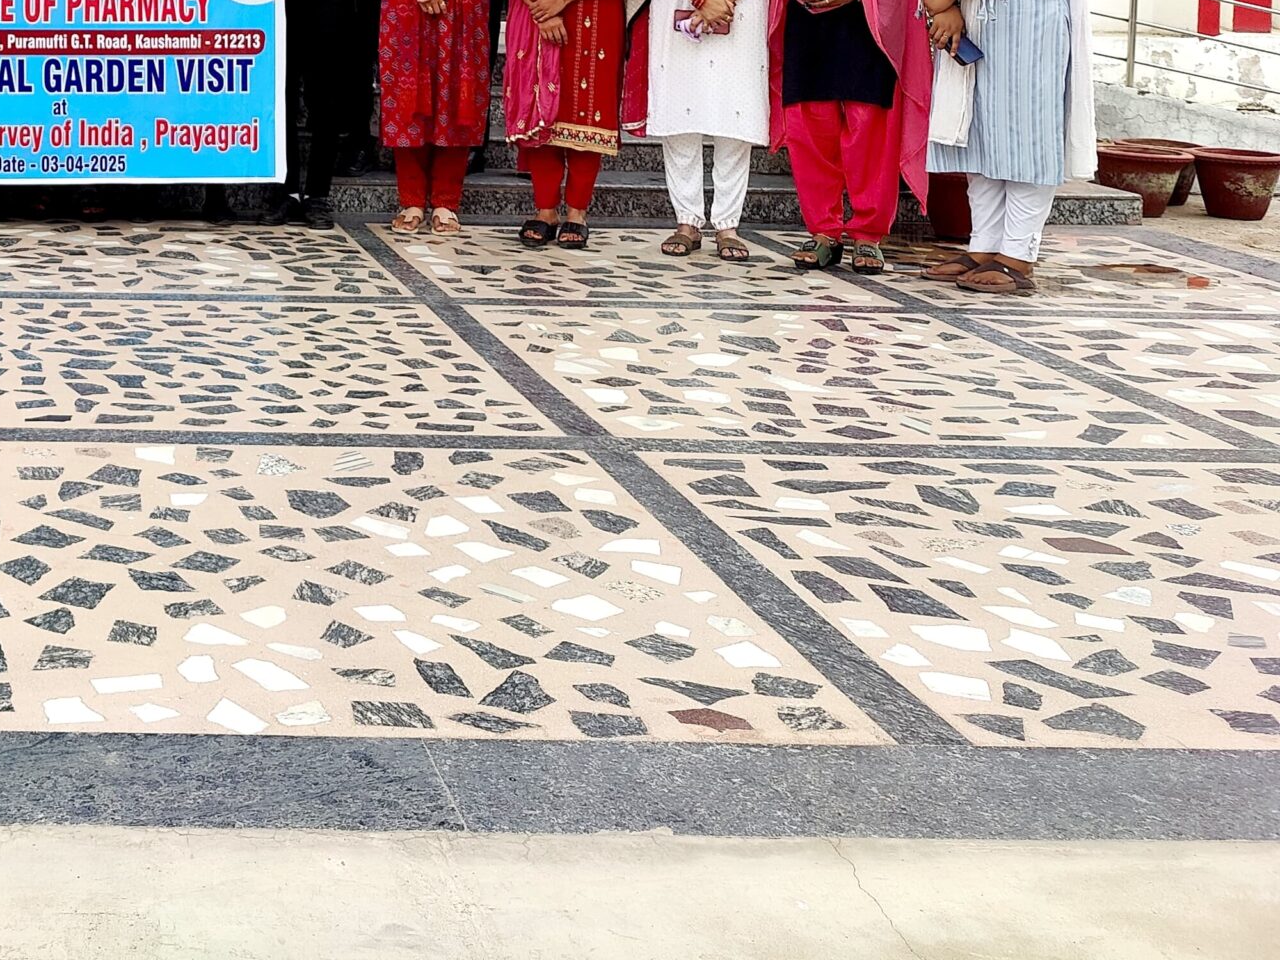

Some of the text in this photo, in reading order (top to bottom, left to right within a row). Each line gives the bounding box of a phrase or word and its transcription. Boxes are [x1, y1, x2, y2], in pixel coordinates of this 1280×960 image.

[7, 34, 68, 49] Puramufti
[71, 34, 93, 49] G.T.
[97, 34, 132, 51] Road,
[135, 34, 202, 49] Kaushambi
[214, 34, 261, 49] 212213
[44, 58, 165, 93] GARDEN
[176, 58, 253, 93] VISIT
[52, 99, 67, 115] at
[51, 119, 72, 146] of
[79, 119, 133, 146] India
[155, 119, 259, 152] Prayagraj
[41, 155, 126, 172] 03-04-2025
